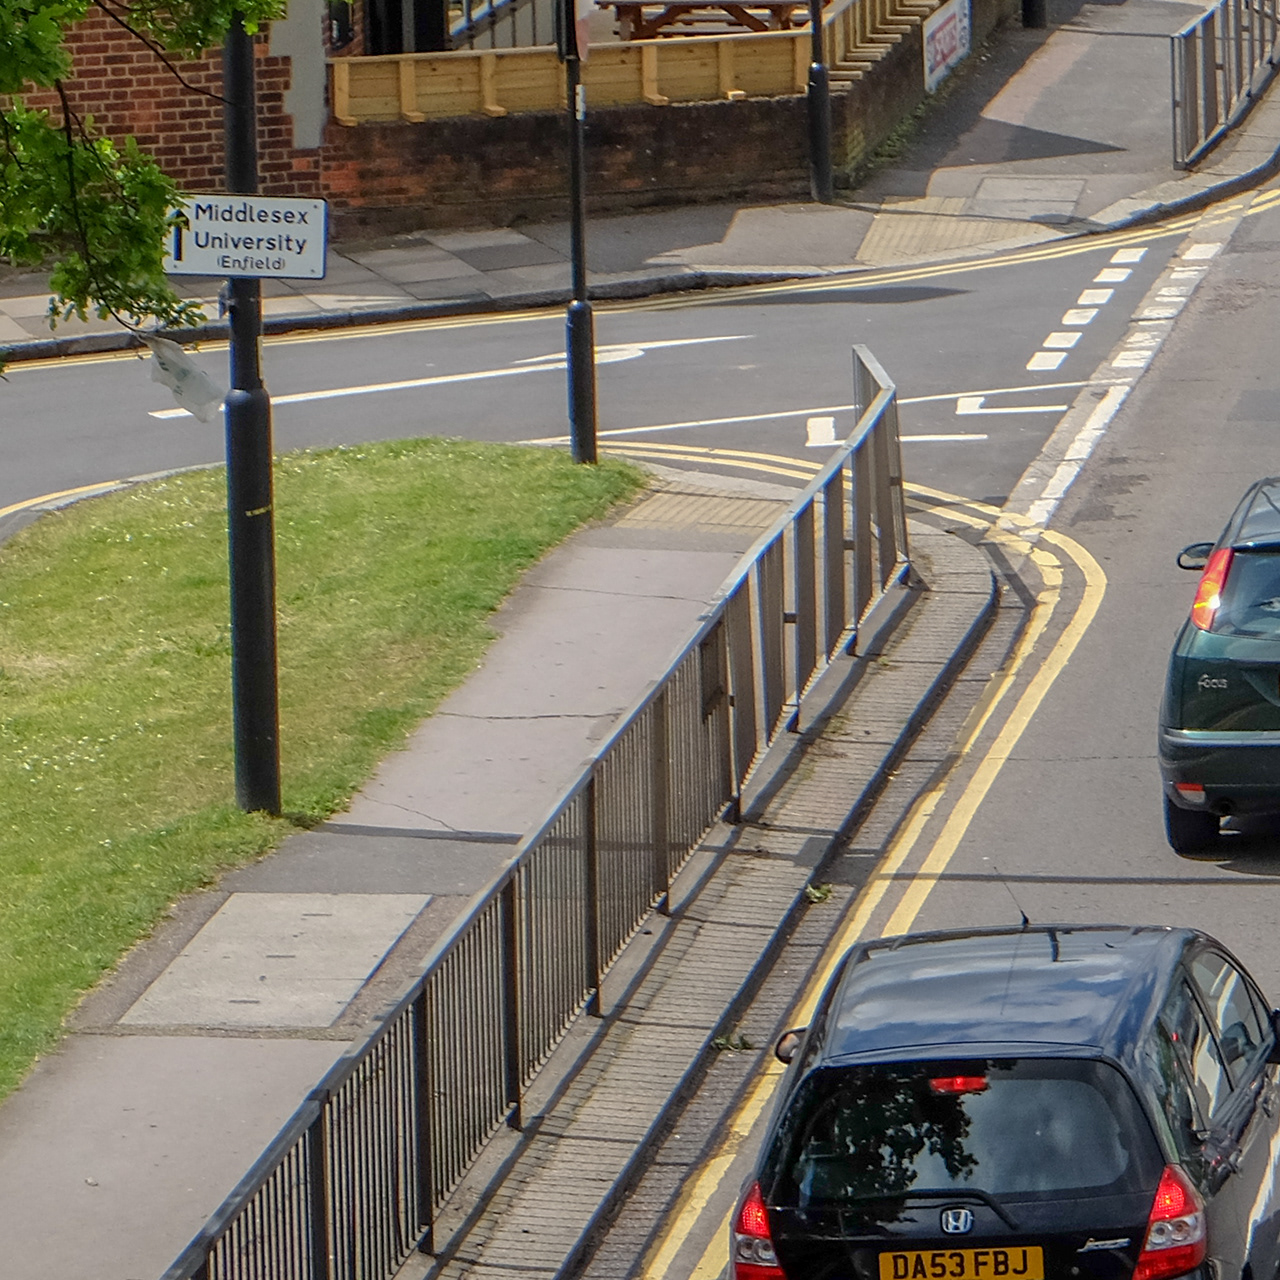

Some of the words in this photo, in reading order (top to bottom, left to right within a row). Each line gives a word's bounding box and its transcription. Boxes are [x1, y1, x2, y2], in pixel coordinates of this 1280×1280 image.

[194, 202, 309, 225] Middlesex
[194, 231, 307, 255] University
[216, 255, 286, 271] (Enfield)
[891, 1253, 965, 1280] DA53
[973, 1249, 1029, 1278] FBJ
